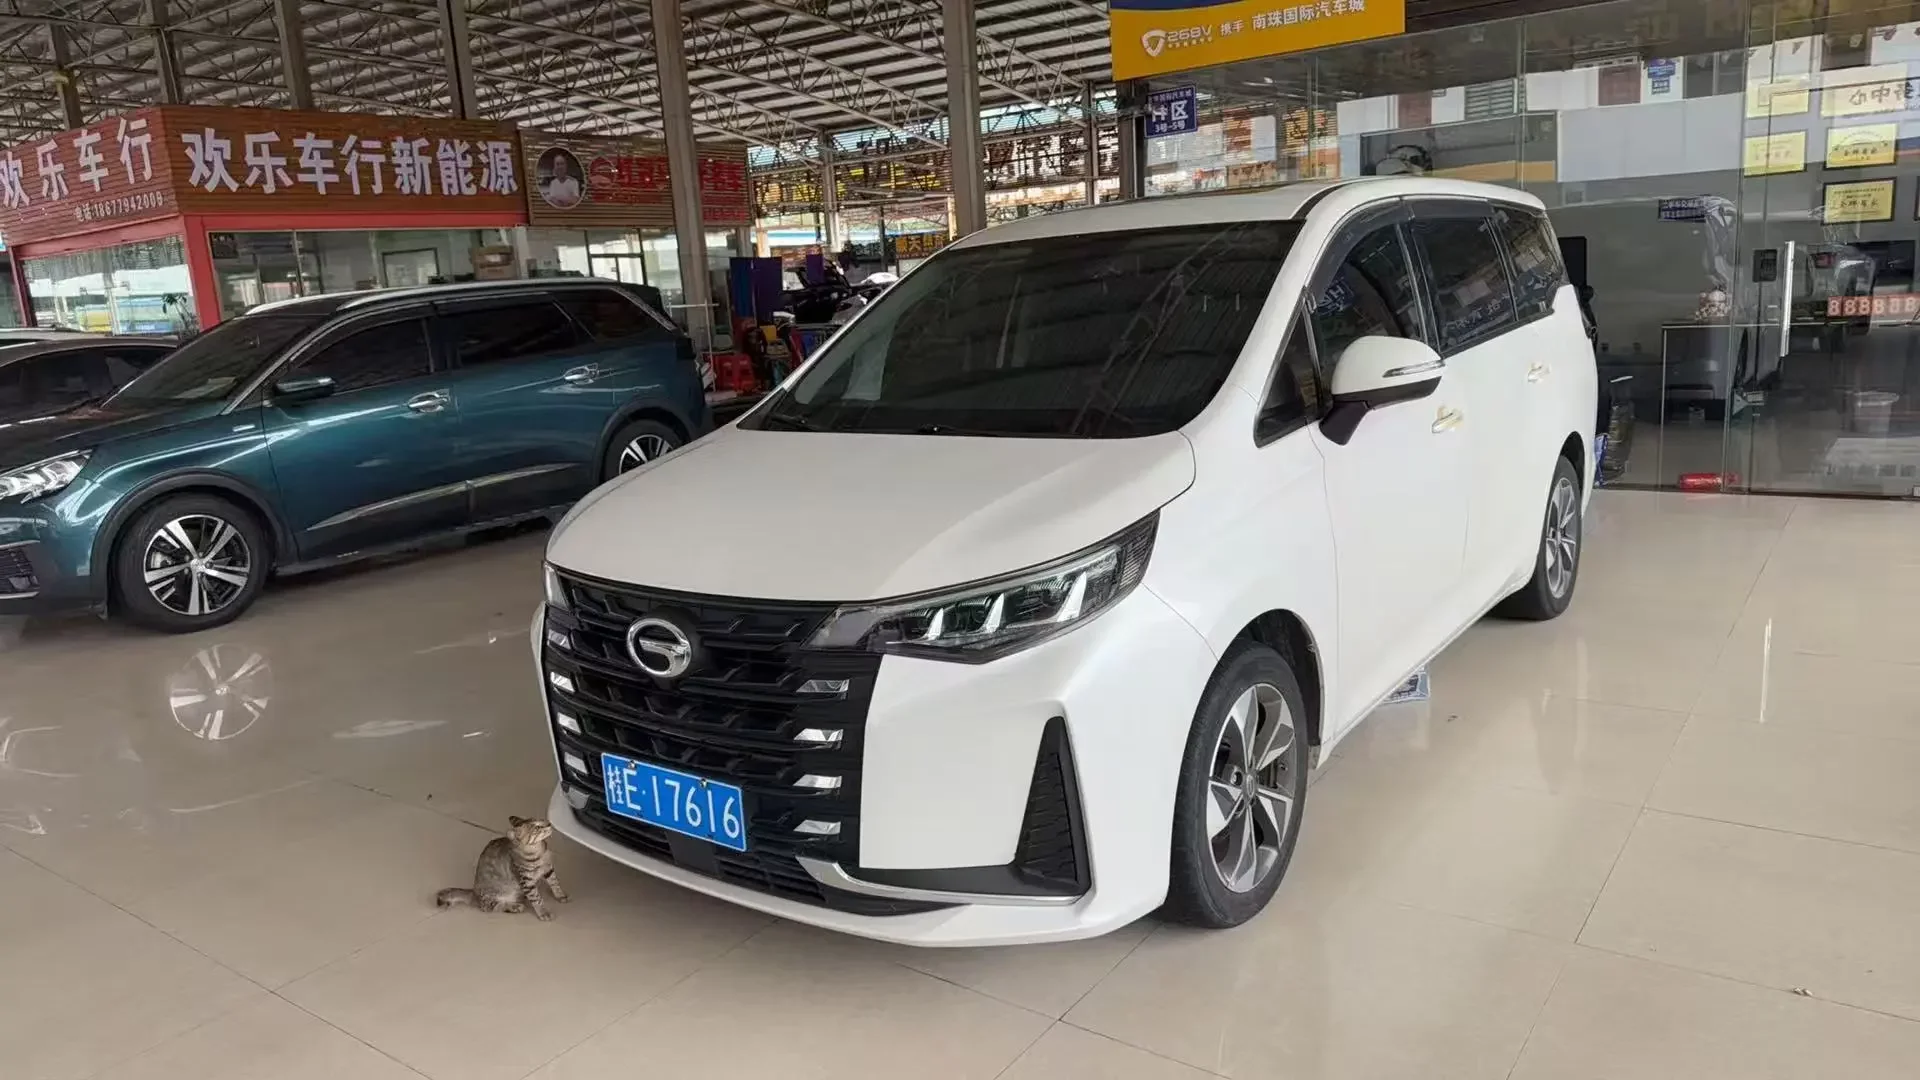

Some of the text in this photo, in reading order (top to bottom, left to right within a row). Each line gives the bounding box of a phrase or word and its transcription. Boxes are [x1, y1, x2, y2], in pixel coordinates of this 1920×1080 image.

[1167, 25, 1212, 42] 268V
[1252, 0, 1365, 30] 南珠国际汽车城
[0, 116, 153, 209] 欢乐车行
[181, 127, 518, 197] 欢乐车行新能源
